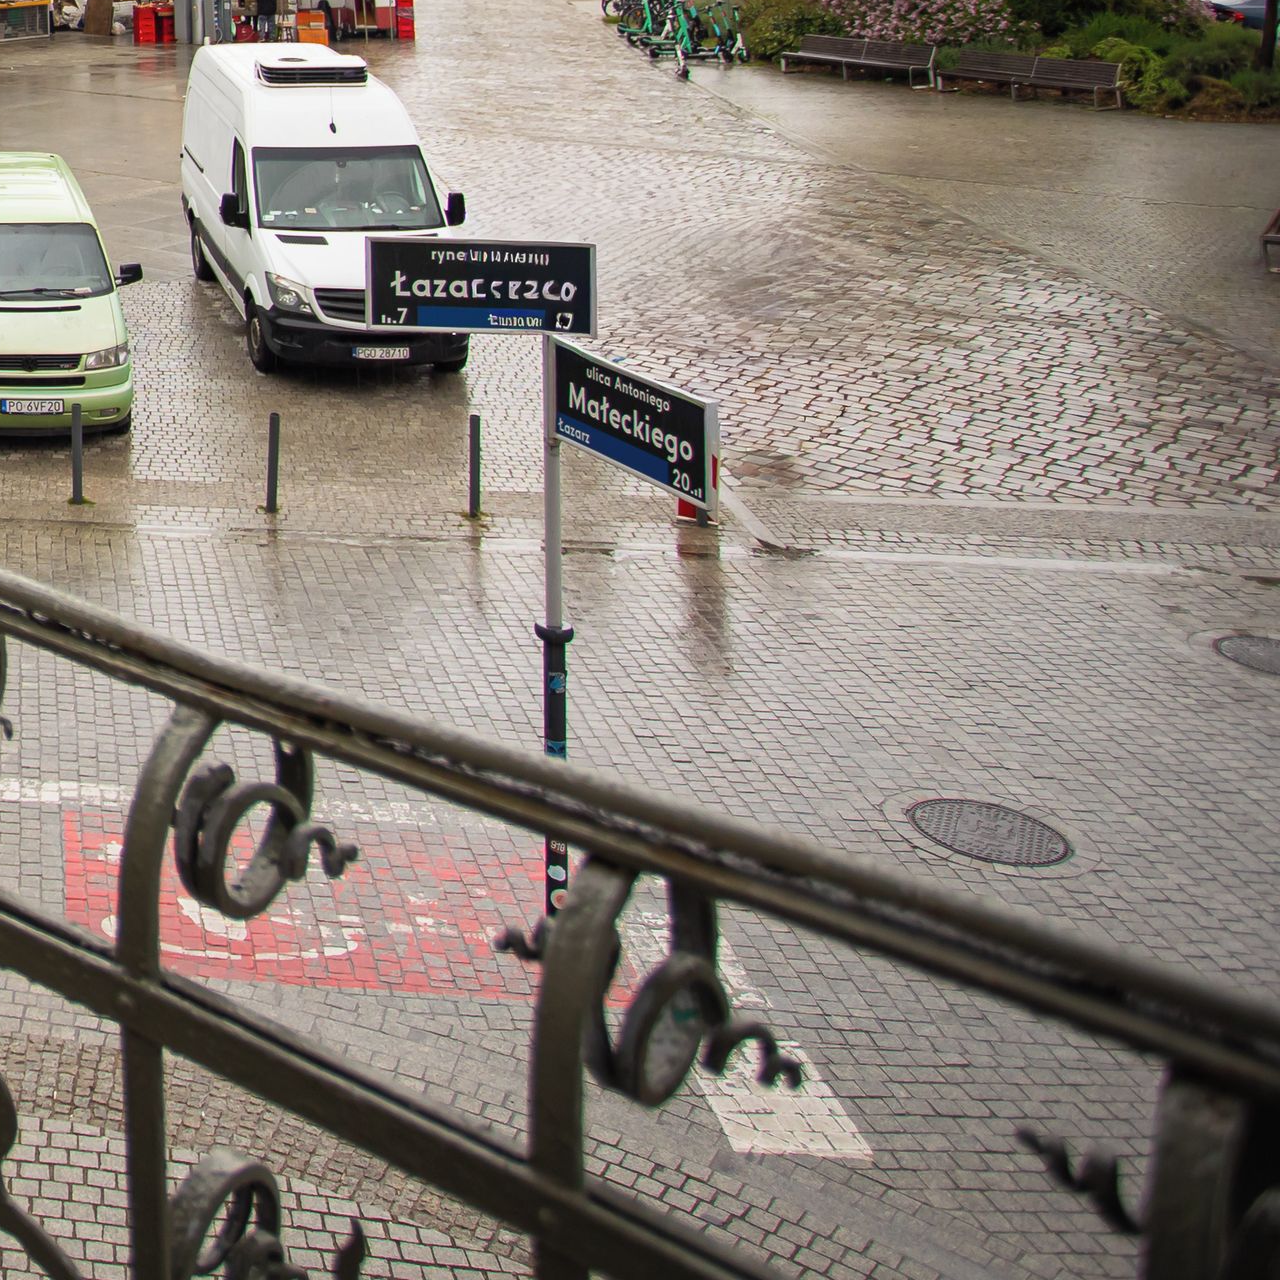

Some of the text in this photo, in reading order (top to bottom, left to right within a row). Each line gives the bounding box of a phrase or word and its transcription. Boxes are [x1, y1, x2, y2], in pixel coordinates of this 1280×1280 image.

[357, 348, 408, 358] PGO 28710
[586, 367, 671, 413] ulica Antoniego
[8, 401, 61, 412] PO 6VF20
[558, 418, 590, 445] Łazarz
[568, 382, 693, 463] Małeckiego
[672, 468, 690, 492] 20
